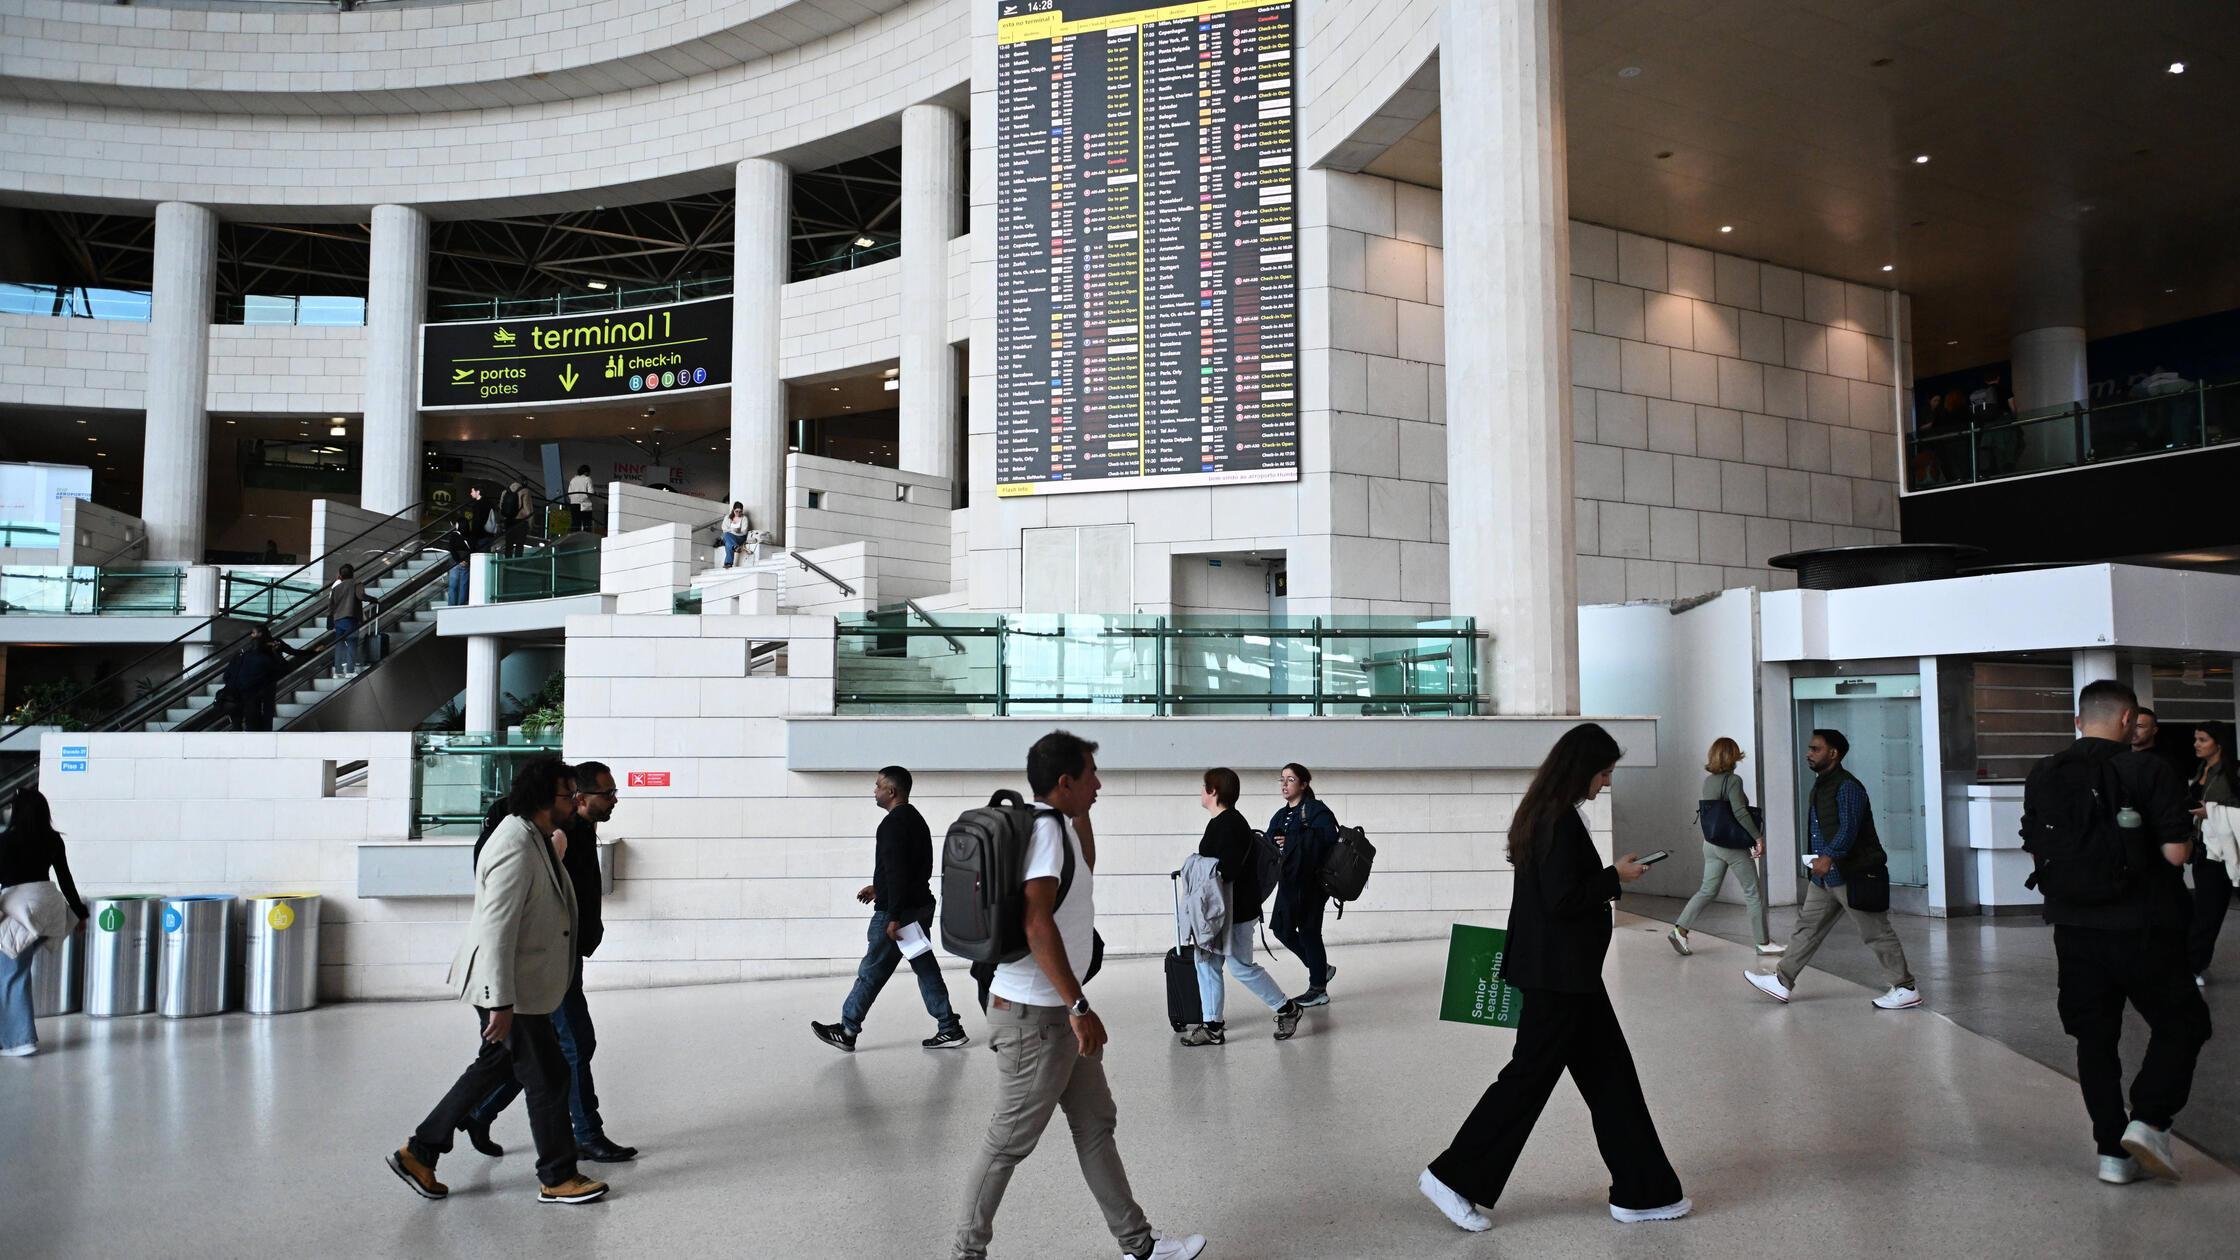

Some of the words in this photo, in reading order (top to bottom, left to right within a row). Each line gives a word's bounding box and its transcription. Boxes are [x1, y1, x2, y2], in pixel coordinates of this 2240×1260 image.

[1027, 0, 1053, 12] 14:28
[531, 313, 653, 350] terminal
[663, 311, 671, 338] 1
[628, 352, 682, 371] check-in
[480, 367, 526, 382] portas
[480, 382, 519, 398] gates
[1484, 952, 1503, 1020] Leadership
[1471, 977, 1487, 1018] Senior
